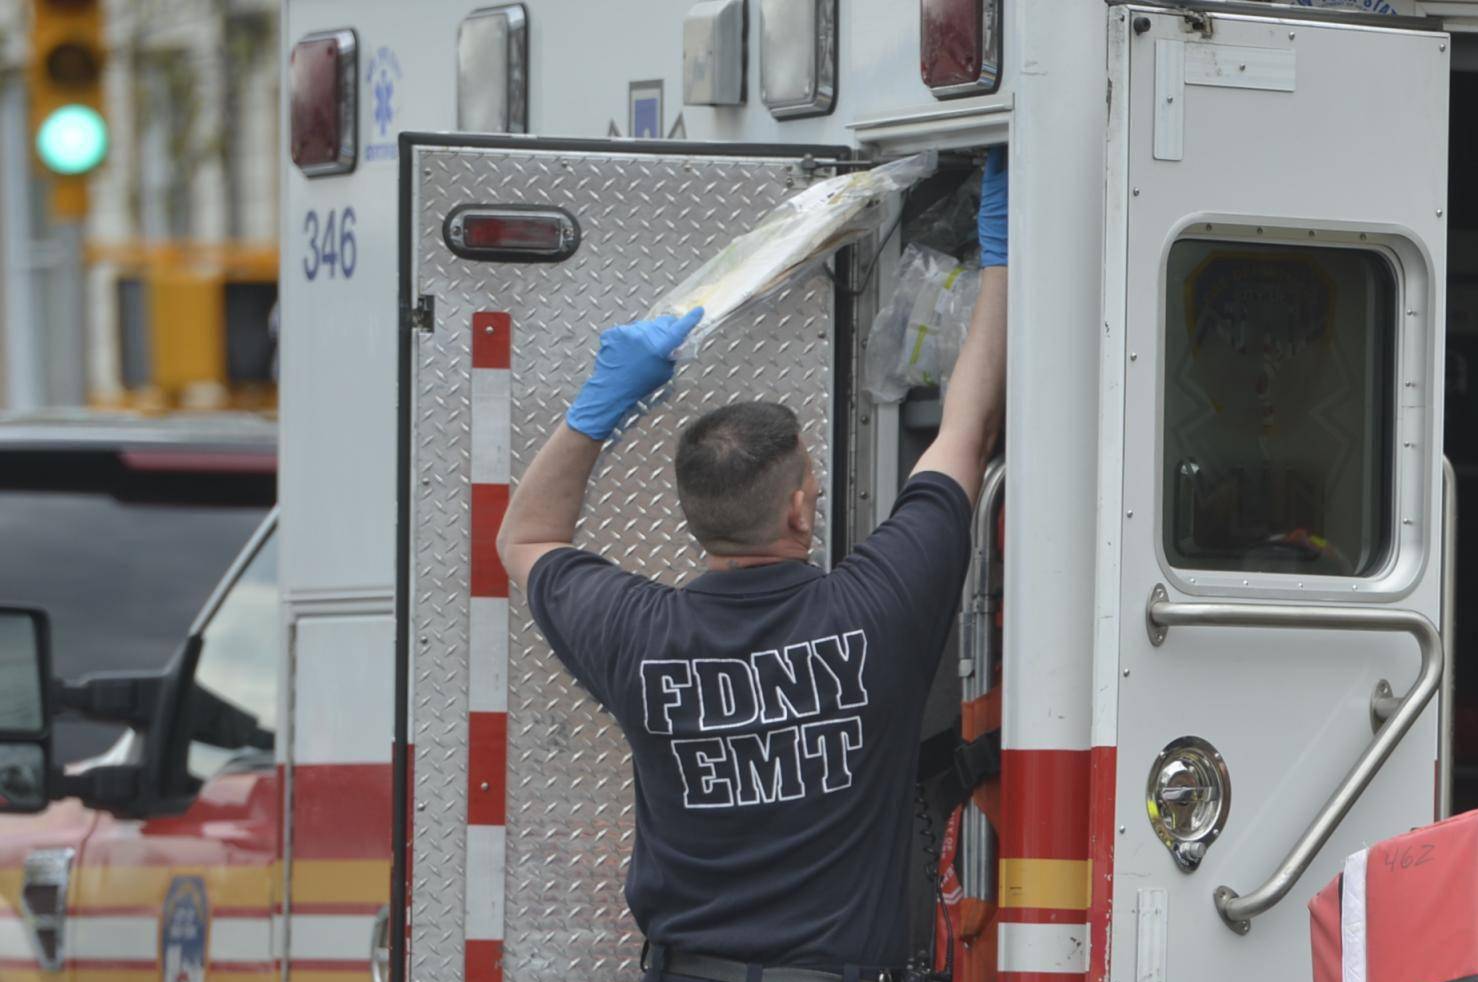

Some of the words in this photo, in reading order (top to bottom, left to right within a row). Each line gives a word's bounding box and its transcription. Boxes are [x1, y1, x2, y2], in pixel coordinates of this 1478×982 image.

[303, 207, 357, 281] 346
[640, 629, 868, 735] FDNY
[671, 716, 863, 808] EMT
